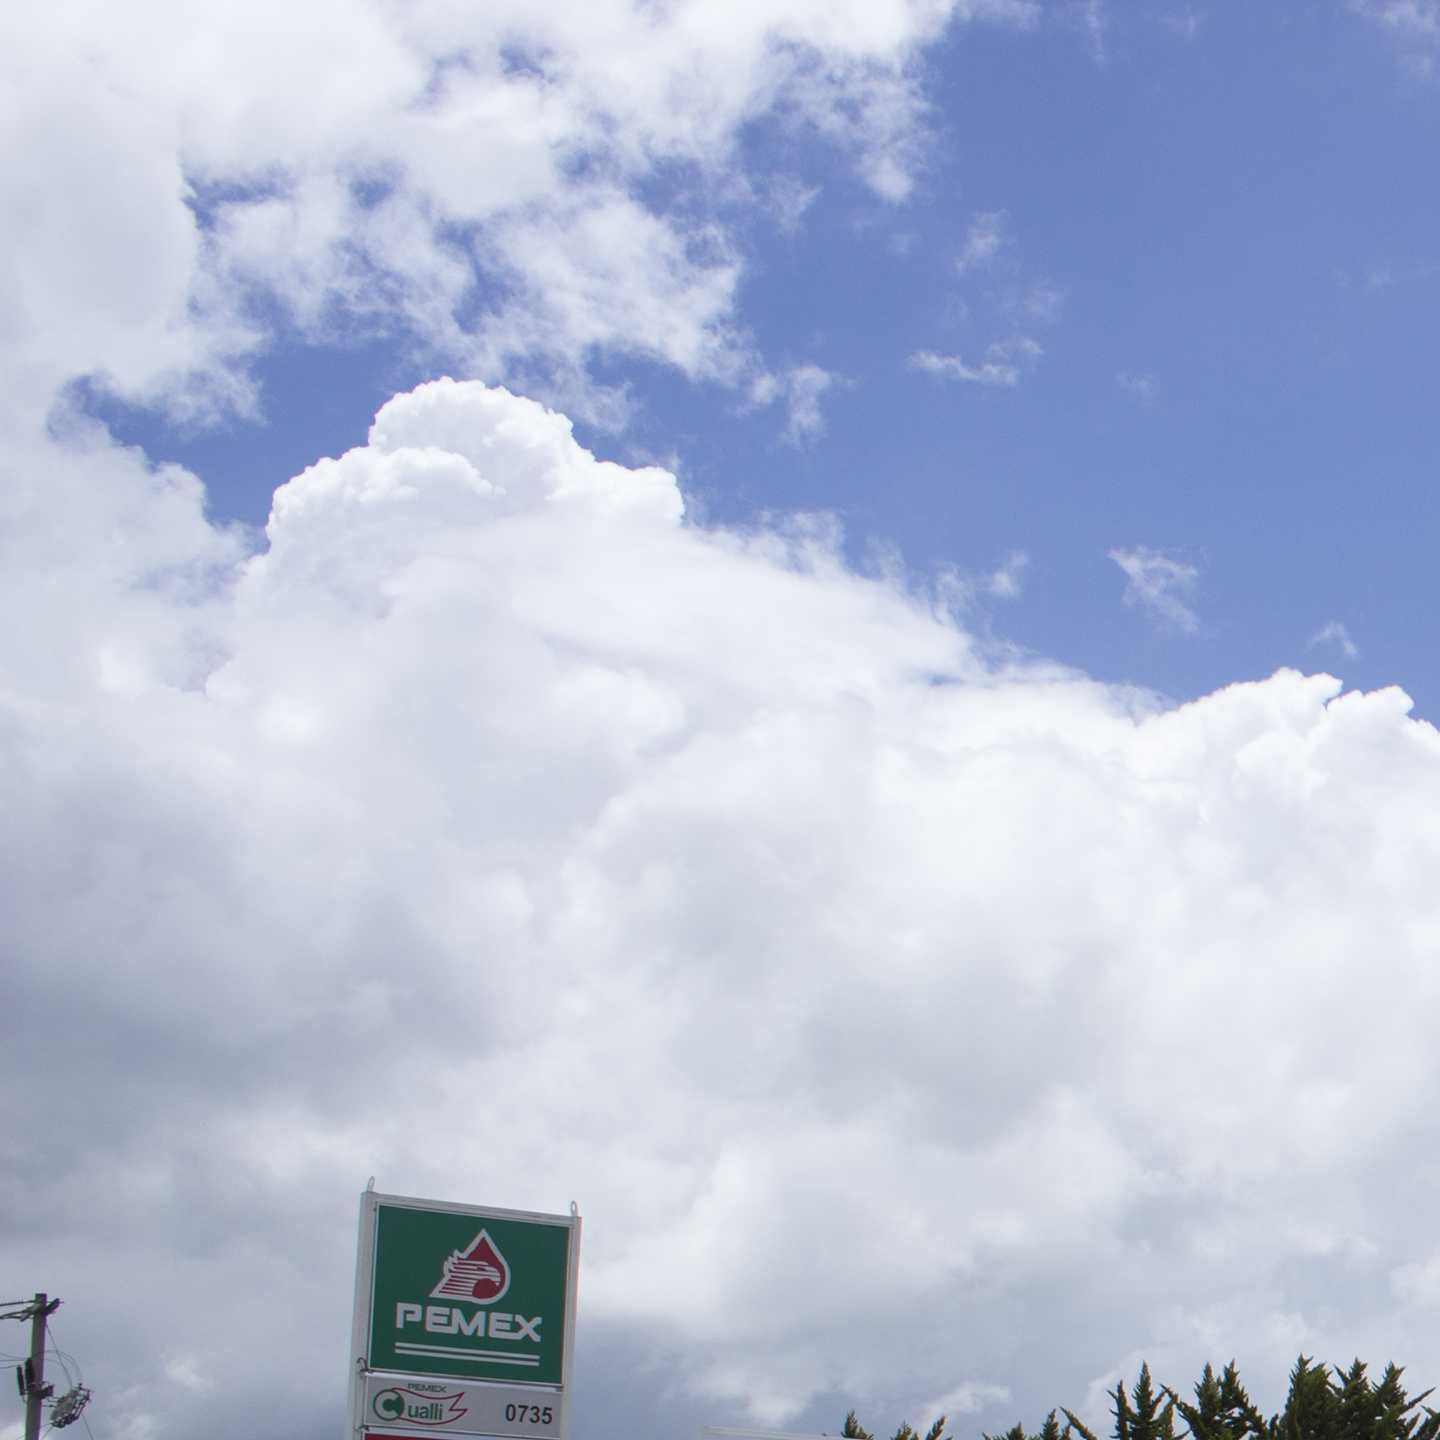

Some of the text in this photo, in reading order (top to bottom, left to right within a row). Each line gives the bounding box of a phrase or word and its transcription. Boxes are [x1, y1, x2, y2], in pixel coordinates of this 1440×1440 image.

[396, 1302, 543, 1343] PEMEX
[408, 1383, 447, 1393] PEMEX
[505, 1404, 553, 1425] 0735
